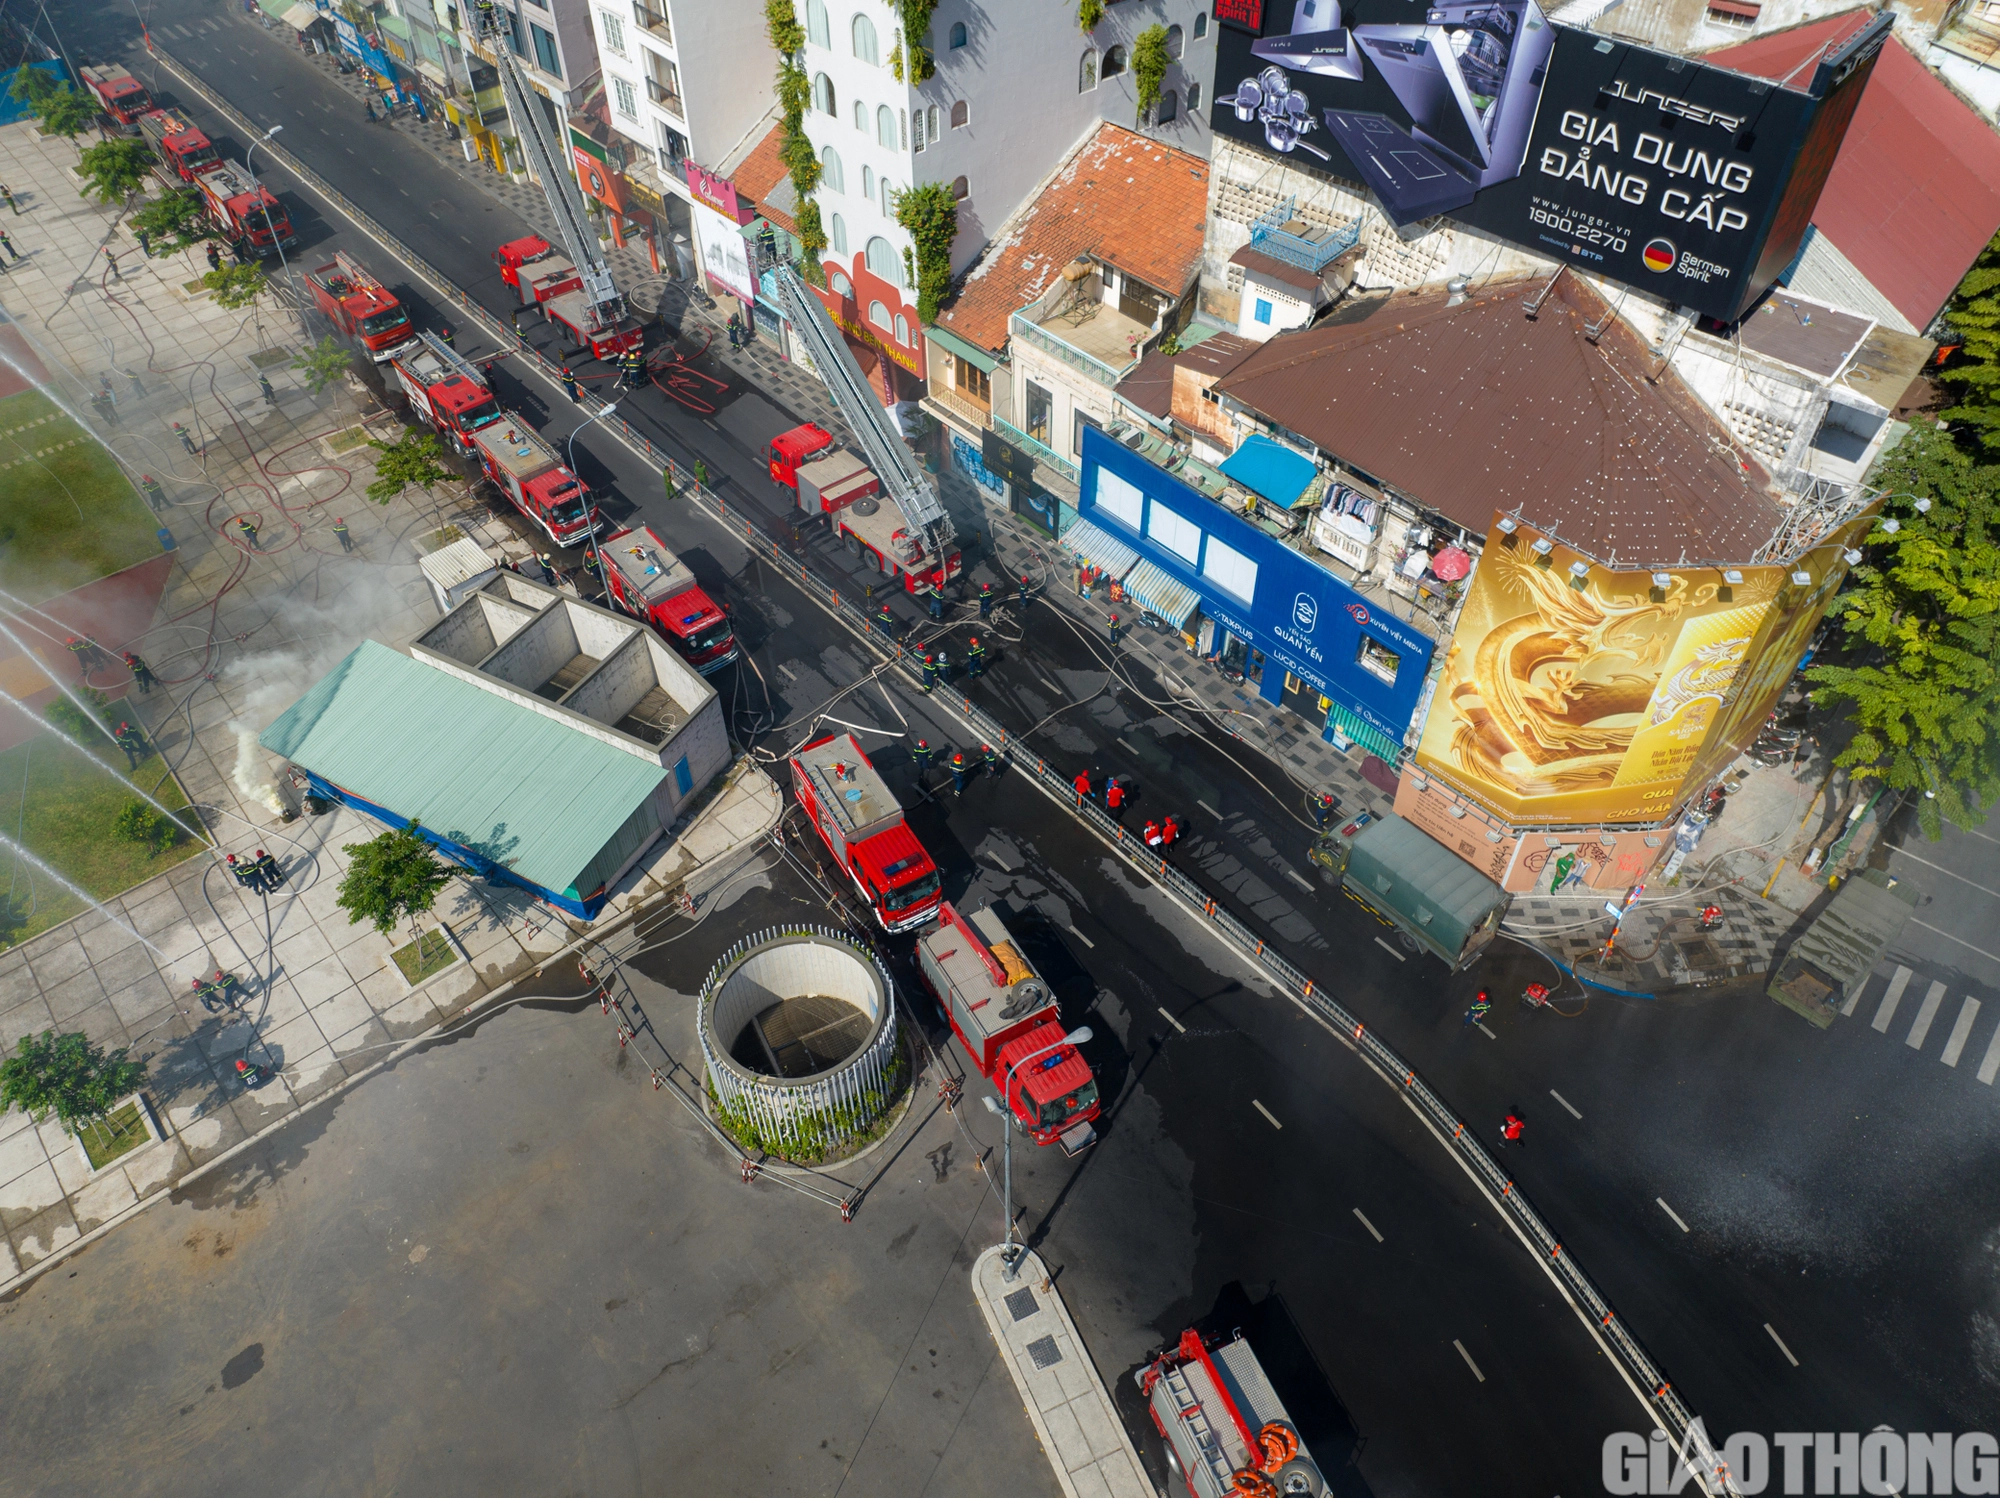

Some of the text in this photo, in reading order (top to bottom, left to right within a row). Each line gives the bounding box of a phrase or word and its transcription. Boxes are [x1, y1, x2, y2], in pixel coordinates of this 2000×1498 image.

[1600, 80, 1740, 133] JUNGER
[1559, 110, 1753, 194] GIA DỤNG
[1539, 146, 1748, 234] ĐẲNG CẤP
[1529, 206, 1627, 254] 1900.2270
[1532, 195, 1632, 237] www.junger.vn
[1539, 234, 1564, 248] Distributed
[1580, 248, 1604, 261] BTP
[1677, 262, 1710, 284] Spirit
[1681, 251, 1730, 279] German
[1274, 626, 1323, 663] QUAN YẾN
[1403, 638, 1422, 655] MEDIA
[1273, 649, 1327, 690] LUCID COFFEE
[1606, 807, 1640, 819] CHO
